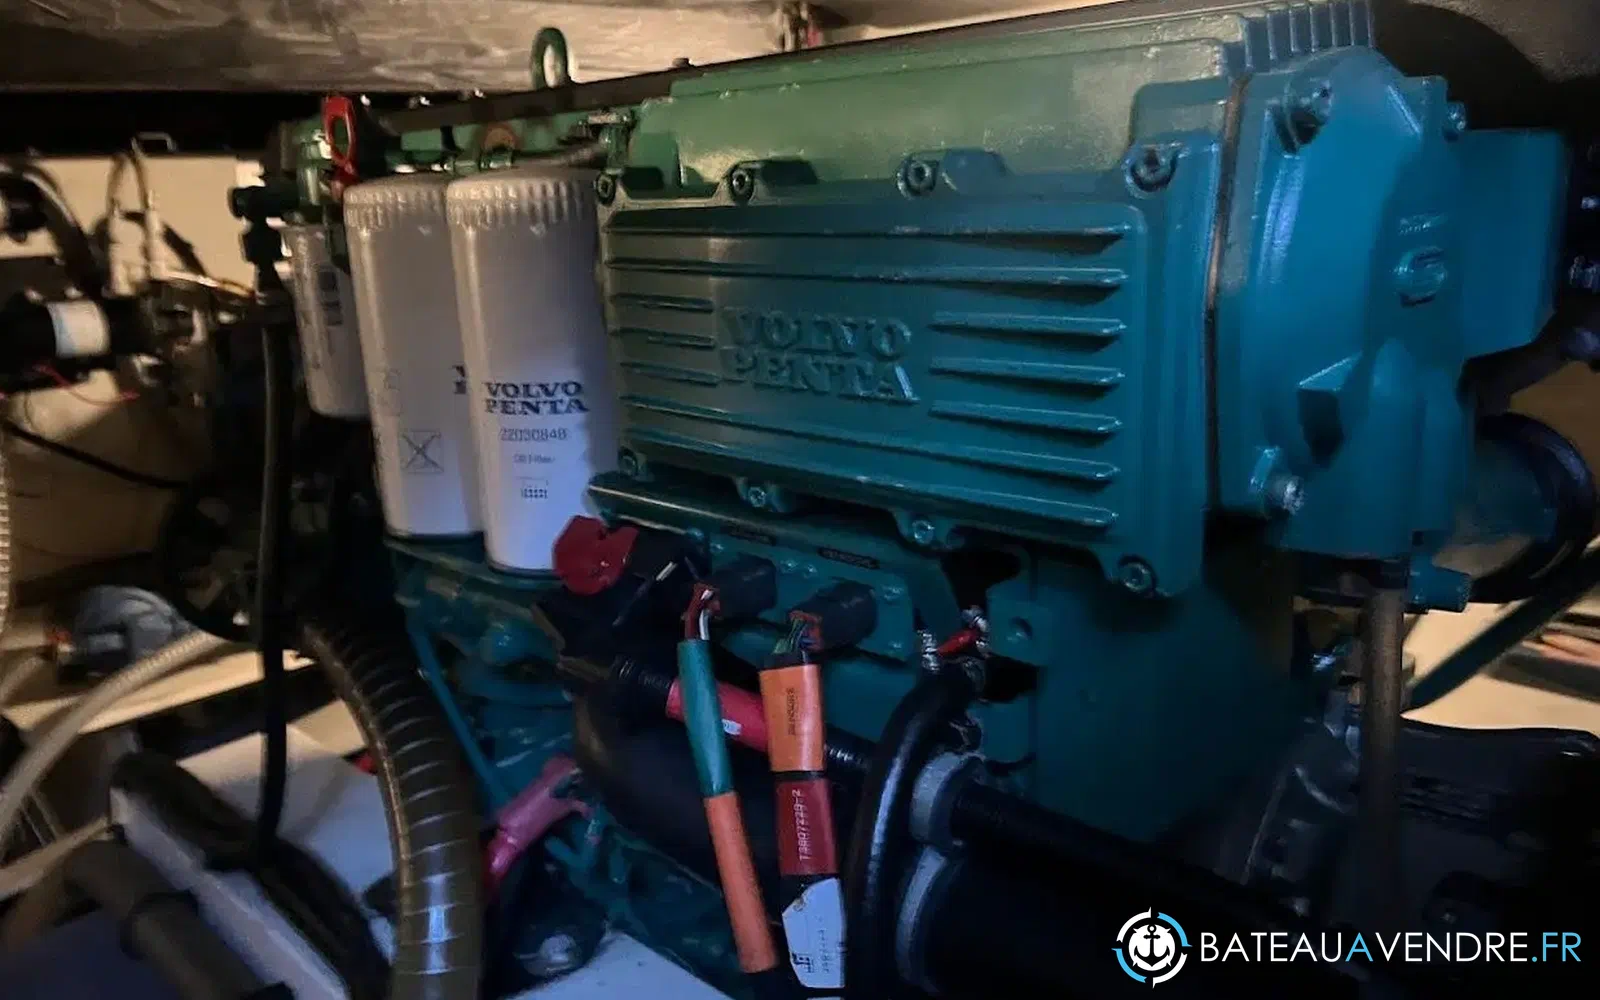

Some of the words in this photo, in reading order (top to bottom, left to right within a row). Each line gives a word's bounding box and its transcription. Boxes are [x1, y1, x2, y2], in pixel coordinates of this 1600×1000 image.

[719, 306, 913, 362] VOLVO
[484, 380, 584, 399] VOLVO
[719, 346, 920, 405] PENTA
[484, 398, 590, 416] PENTA
